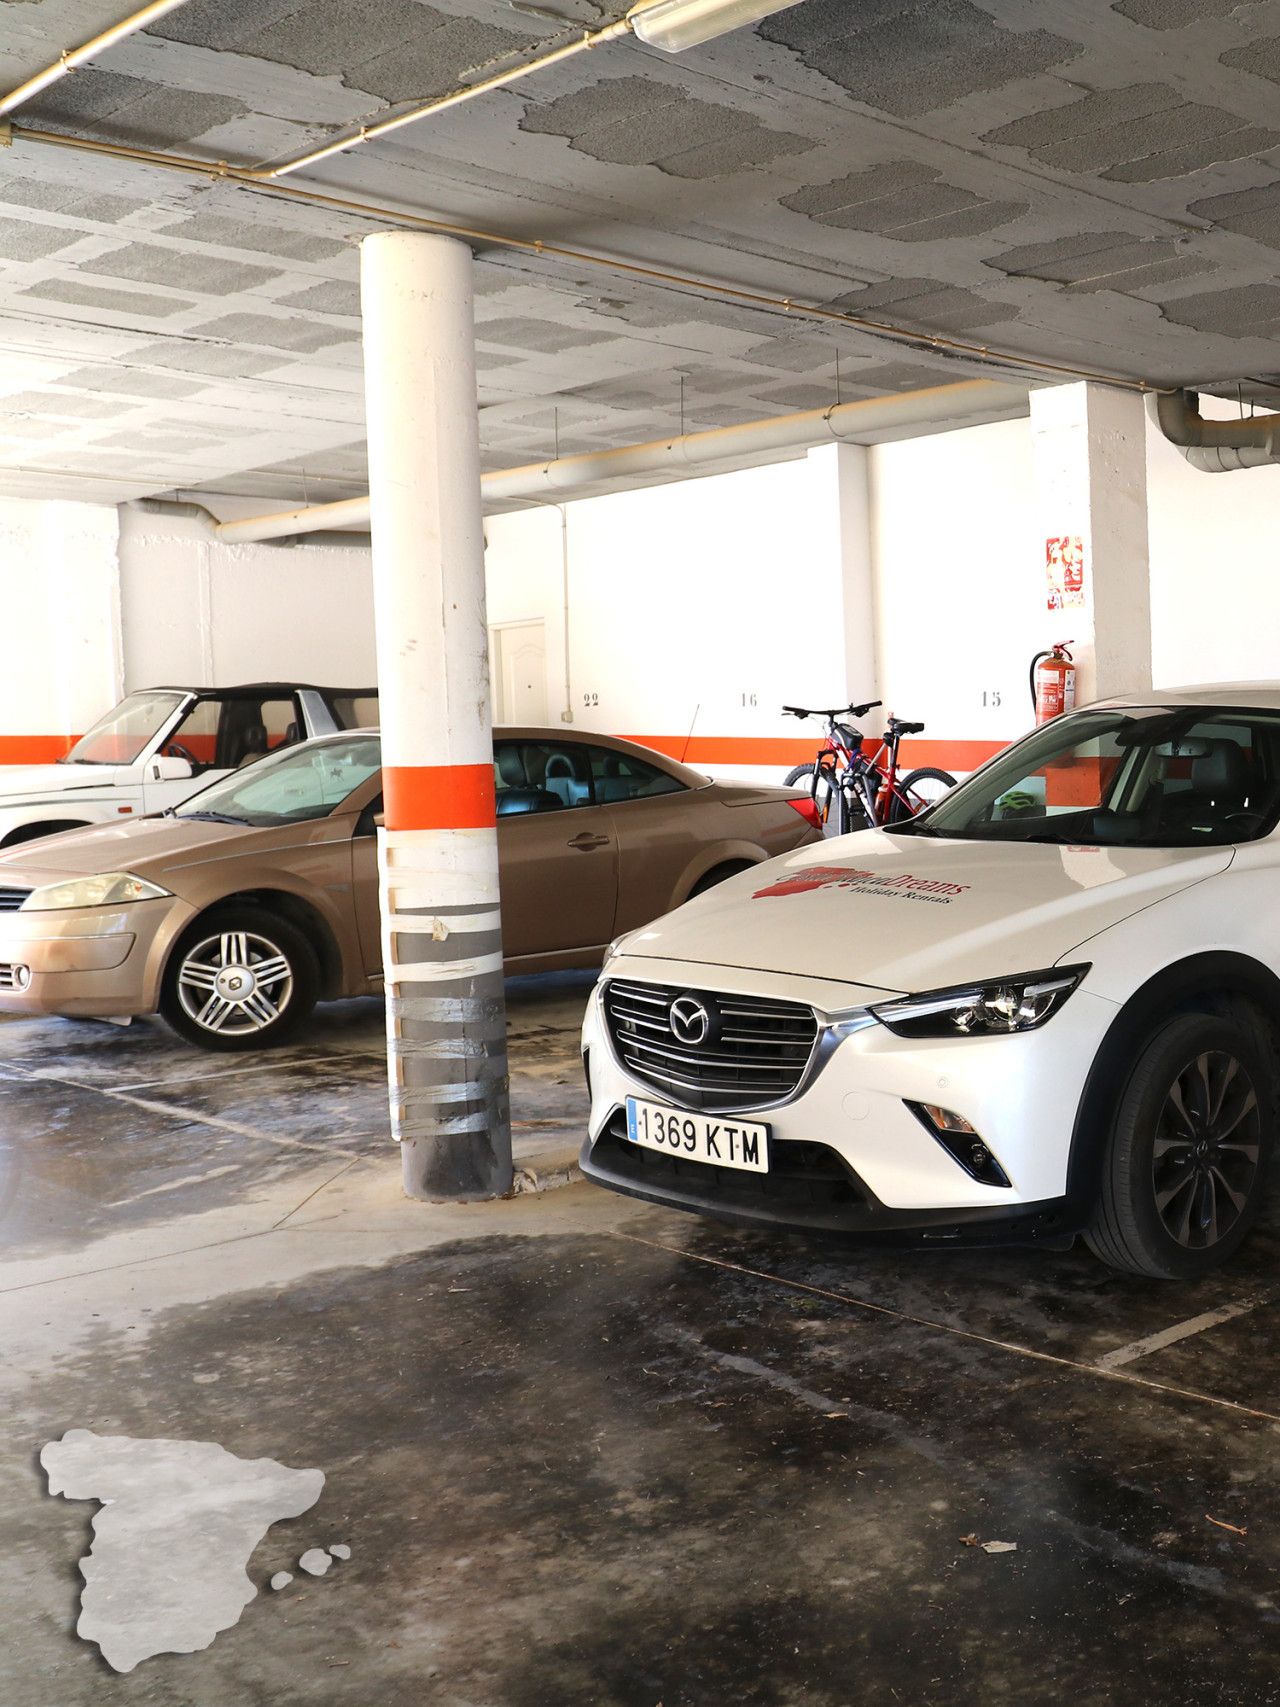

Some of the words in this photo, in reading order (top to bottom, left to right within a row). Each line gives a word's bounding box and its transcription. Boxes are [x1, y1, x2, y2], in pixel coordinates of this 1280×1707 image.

[583, 693, 599, 707] 22
[741, 692, 757, 707] 16
[981, 691, 1002, 707] 15
[849, 886, 902, 899] Holiday
[902, 891, 953, 905] Rentals
[642, 1108, 696, 1152] 1369
[706, 1123, 759, 1165] KTM
